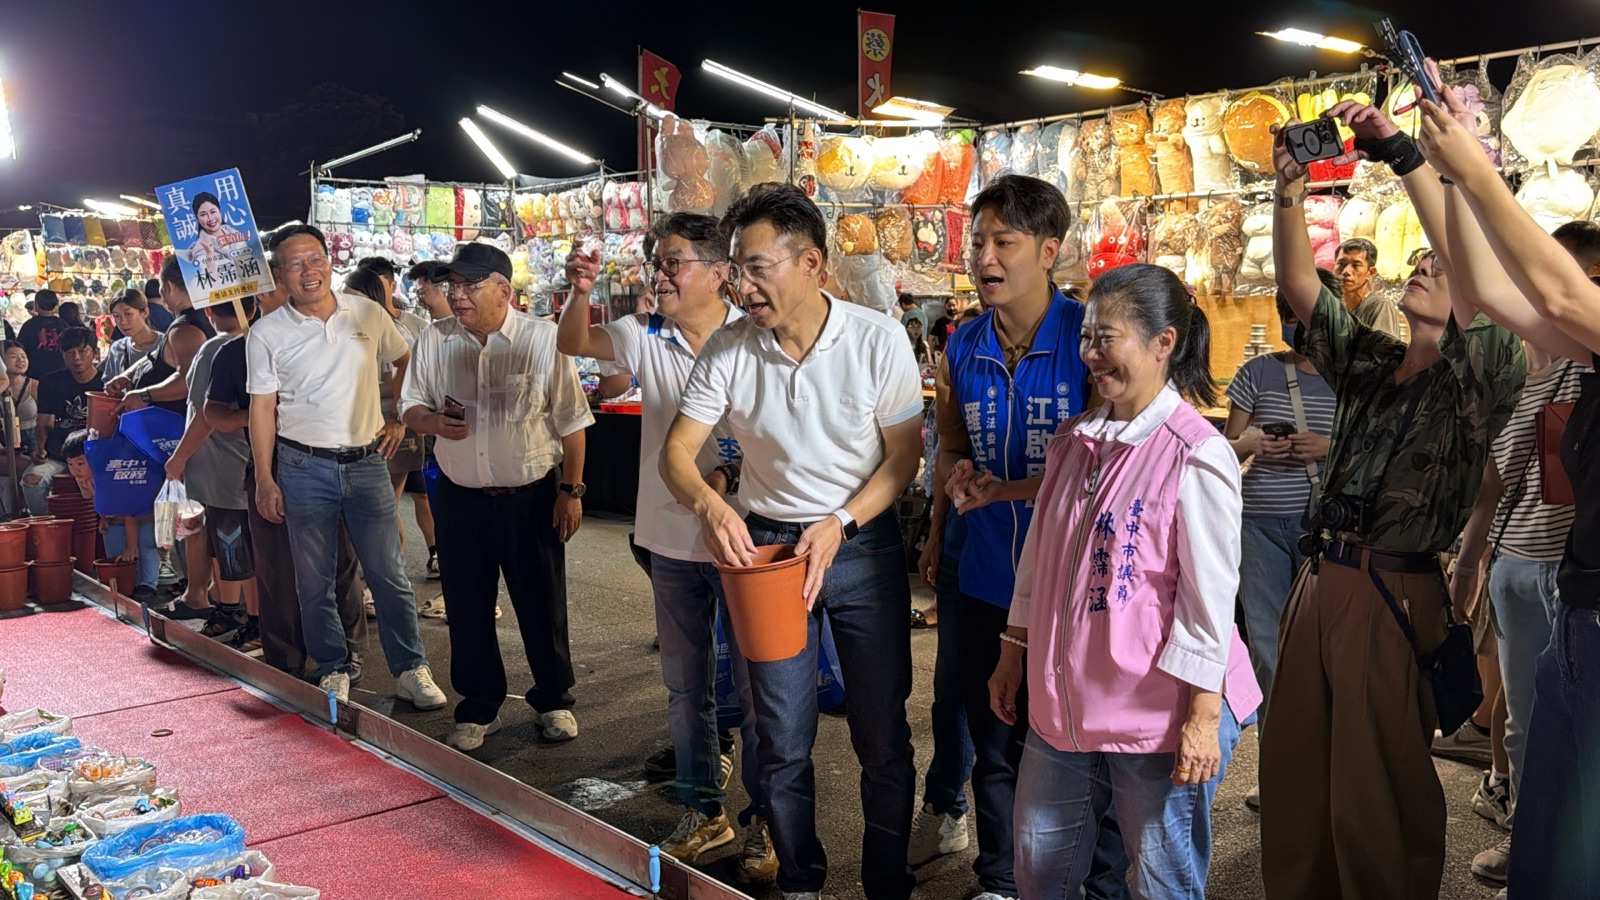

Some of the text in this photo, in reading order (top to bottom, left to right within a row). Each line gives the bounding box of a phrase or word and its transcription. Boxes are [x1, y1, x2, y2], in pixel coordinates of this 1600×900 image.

[164, 186, 199, 241] 真誠
[214, 174, 247, 226] 用心
[195, 257, 261, 290] 林霈涵
[985, 400, 998, 461] 立法委員
[1087, 510, 1116, 614] 林霈涵
[1115, 498, 1145, 603] 臺中市議員
